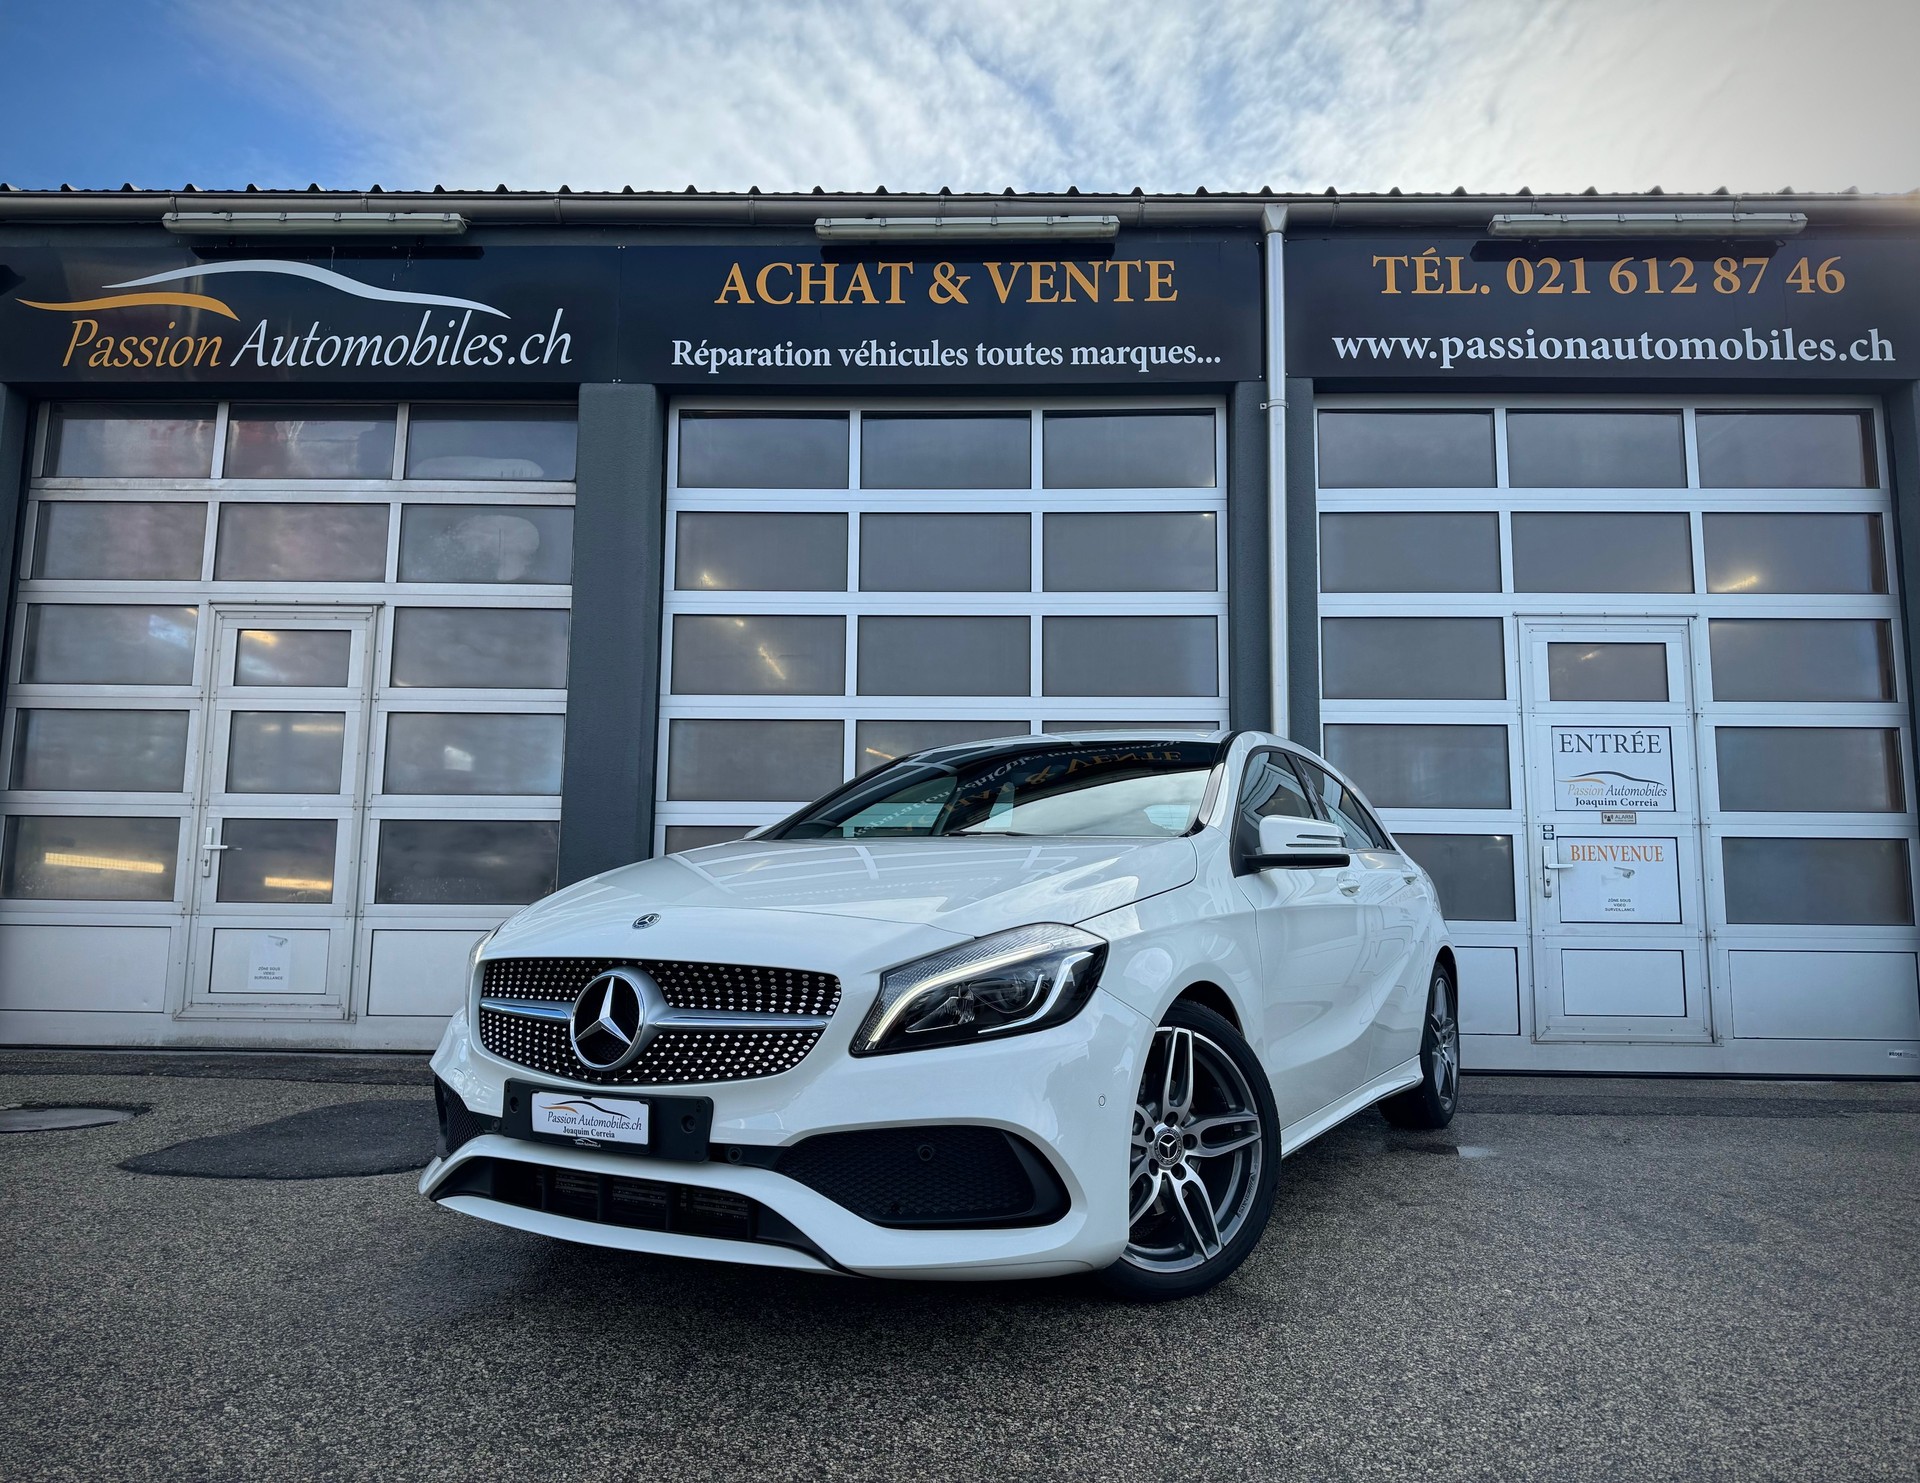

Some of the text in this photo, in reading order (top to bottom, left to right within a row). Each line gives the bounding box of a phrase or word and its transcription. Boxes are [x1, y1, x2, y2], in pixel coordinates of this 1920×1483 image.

[713, 259, 1179, 305] ACHAT & VENTE
[1372, 246, 1846, 295] TÉL. 021 612 87 46
[62, 308, 573, 368] Passion Automobiles.ch
[1331, 327, 1896, 369] www.passionautomobiles.ch
[671, 340, 1221, 374] Réparation véhicules toutes marques...
[1558, 730, 1662, 754] ENTRÉE
[1567, 783, 1668, 797] Passion Automobiles
[1575, 797, 1659, 808] Joaquim Correia
[1570, 845, 1664, 863] BIENVENUE
[547, 1111, 642, 1131] Passion Automobiles.ch
[562, 1126, 615, 1139] Joaquim Correia
